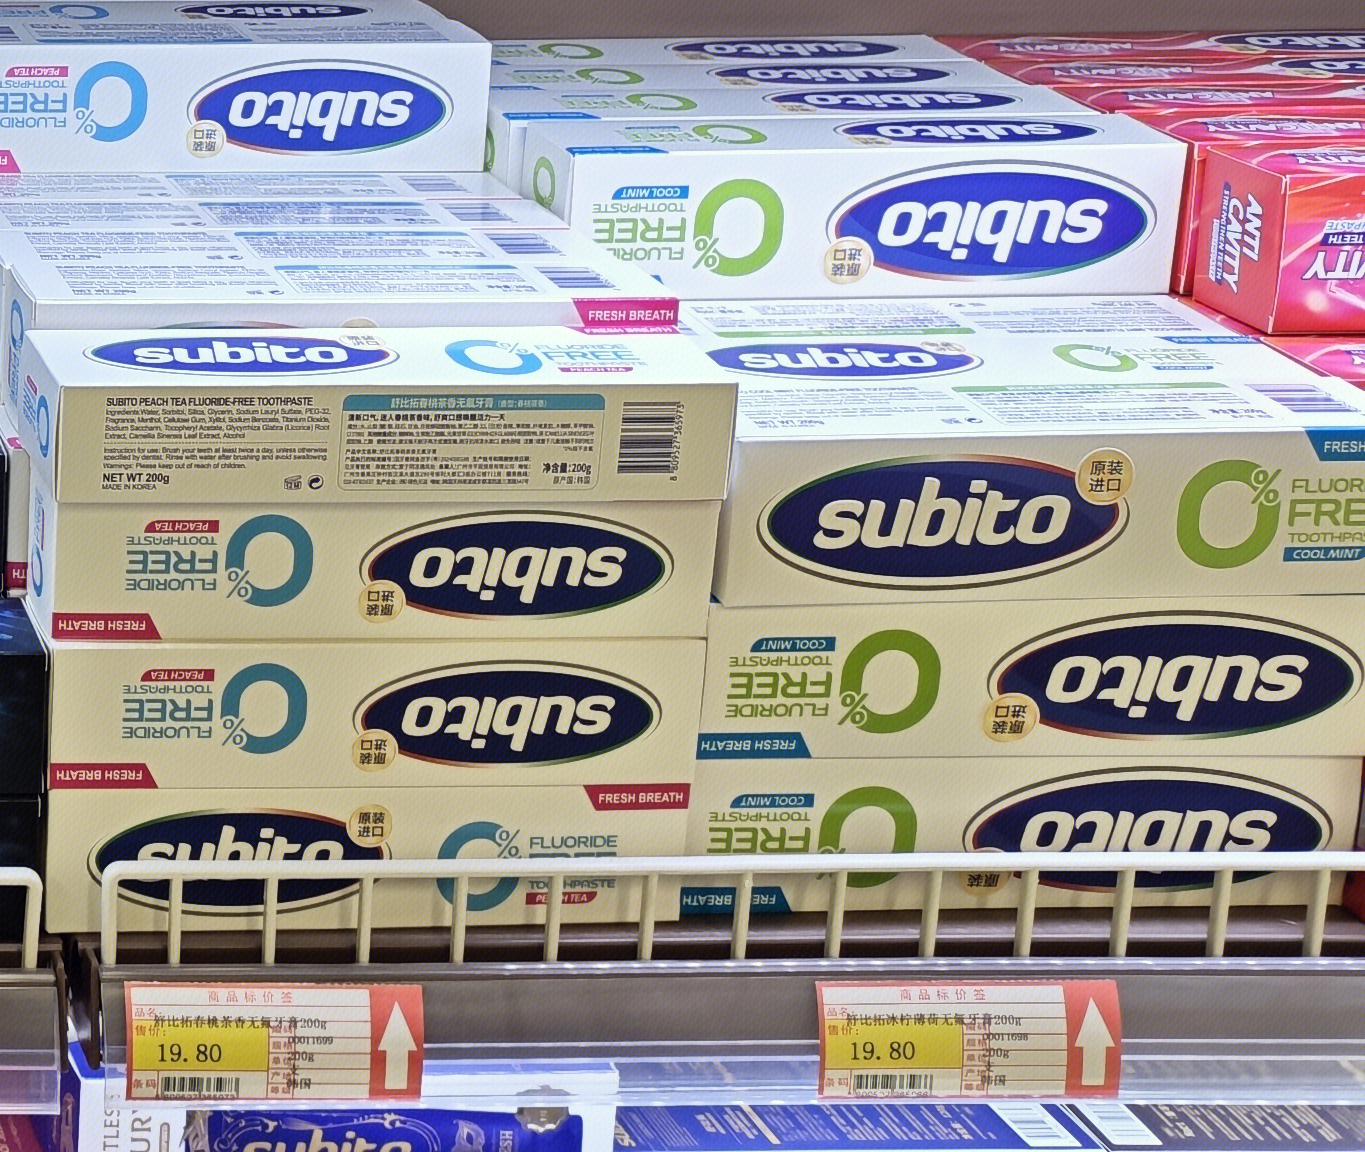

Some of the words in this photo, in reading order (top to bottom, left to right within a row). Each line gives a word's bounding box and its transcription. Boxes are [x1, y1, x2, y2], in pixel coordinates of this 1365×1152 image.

[13, 67, 29, 76] TEA
[31, 67, 60, 76] PEACH
[229, 89, 412, 141] subito
[879, 197, 1107, 264] subito
[1242, 193, 1263, 261] ANTI
[1222, 198, 1244, 294] CAVITY
[588, 308, 626, 321] FRESH
[627, 309, 677, 323] BREATH
[106, 398, 137, 406] SUBITO
[139, 398, 168, 406] PEACH
[171, 398, 187, 406] TEA
[189, 397, 255, 406] FLUORIDE-FREE
[257, 397, 313, 406] TOOTHPASTE
[103, 474, 123, 482] NET
[127, 474, 143, 482] WT
[146, 474, 169, 483] 200g
[811, 478, 1072, 549] subito
[1293, 549, 1324, 559] COOL
[1327, 549, 1361, 559] MINT
[408, 547, 626, 601] subito
[727, 672, 832, 698] FREE
[725, 704, 829, 718] FLUORIDE
[158, 1043, 222, 1062] 19.80
[850, 1041, 915, 1060] 19.80
